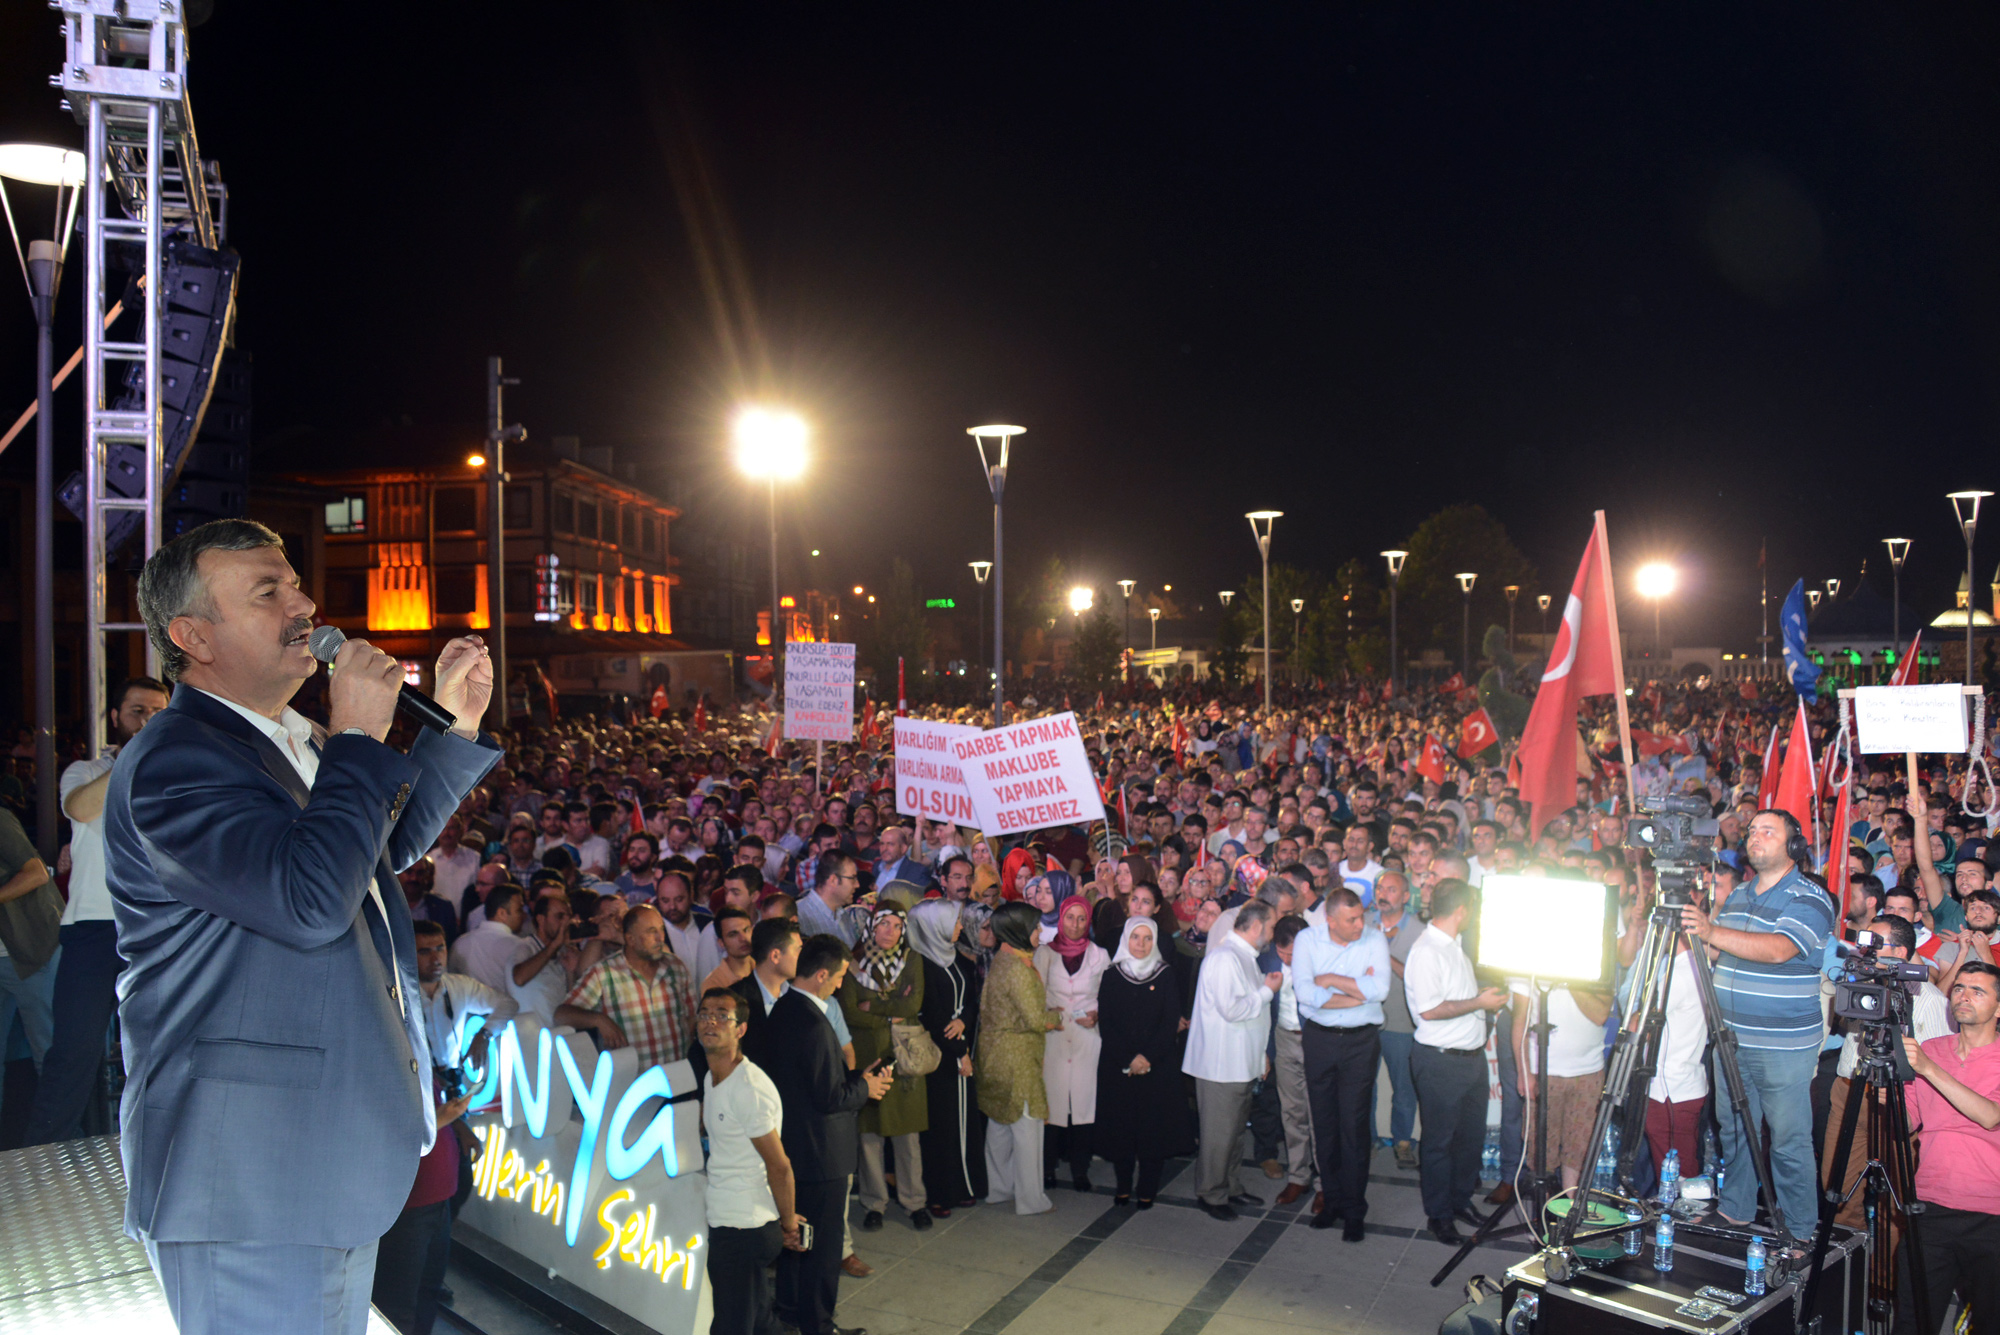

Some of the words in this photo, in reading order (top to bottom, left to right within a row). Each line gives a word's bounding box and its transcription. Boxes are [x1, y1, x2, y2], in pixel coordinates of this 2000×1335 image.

[785, 643, 828, 655] ONURSUZ
[785, 671, 821, 682] ONURLU
[832, 671, 852, 683] GÜN
[895, 730, 947, 752] VARLIĞIM
[955, 733, 1006, 760] DARBE
[1007, 718, 1075, 749] YAPMAK
[898, 758, 938, 782] VARLIĞINA
[940, 765, 965, 786] ARMA
[984, 749, 1061, 781] MAKLUBE
[905, 785, 972, 820] OLSUN
[993, 775, 1068, 805] YAPMAYA
[996, 799, 1082, 830] BENZEMEZ
[592, 1188, 703, 1290] Şehri
